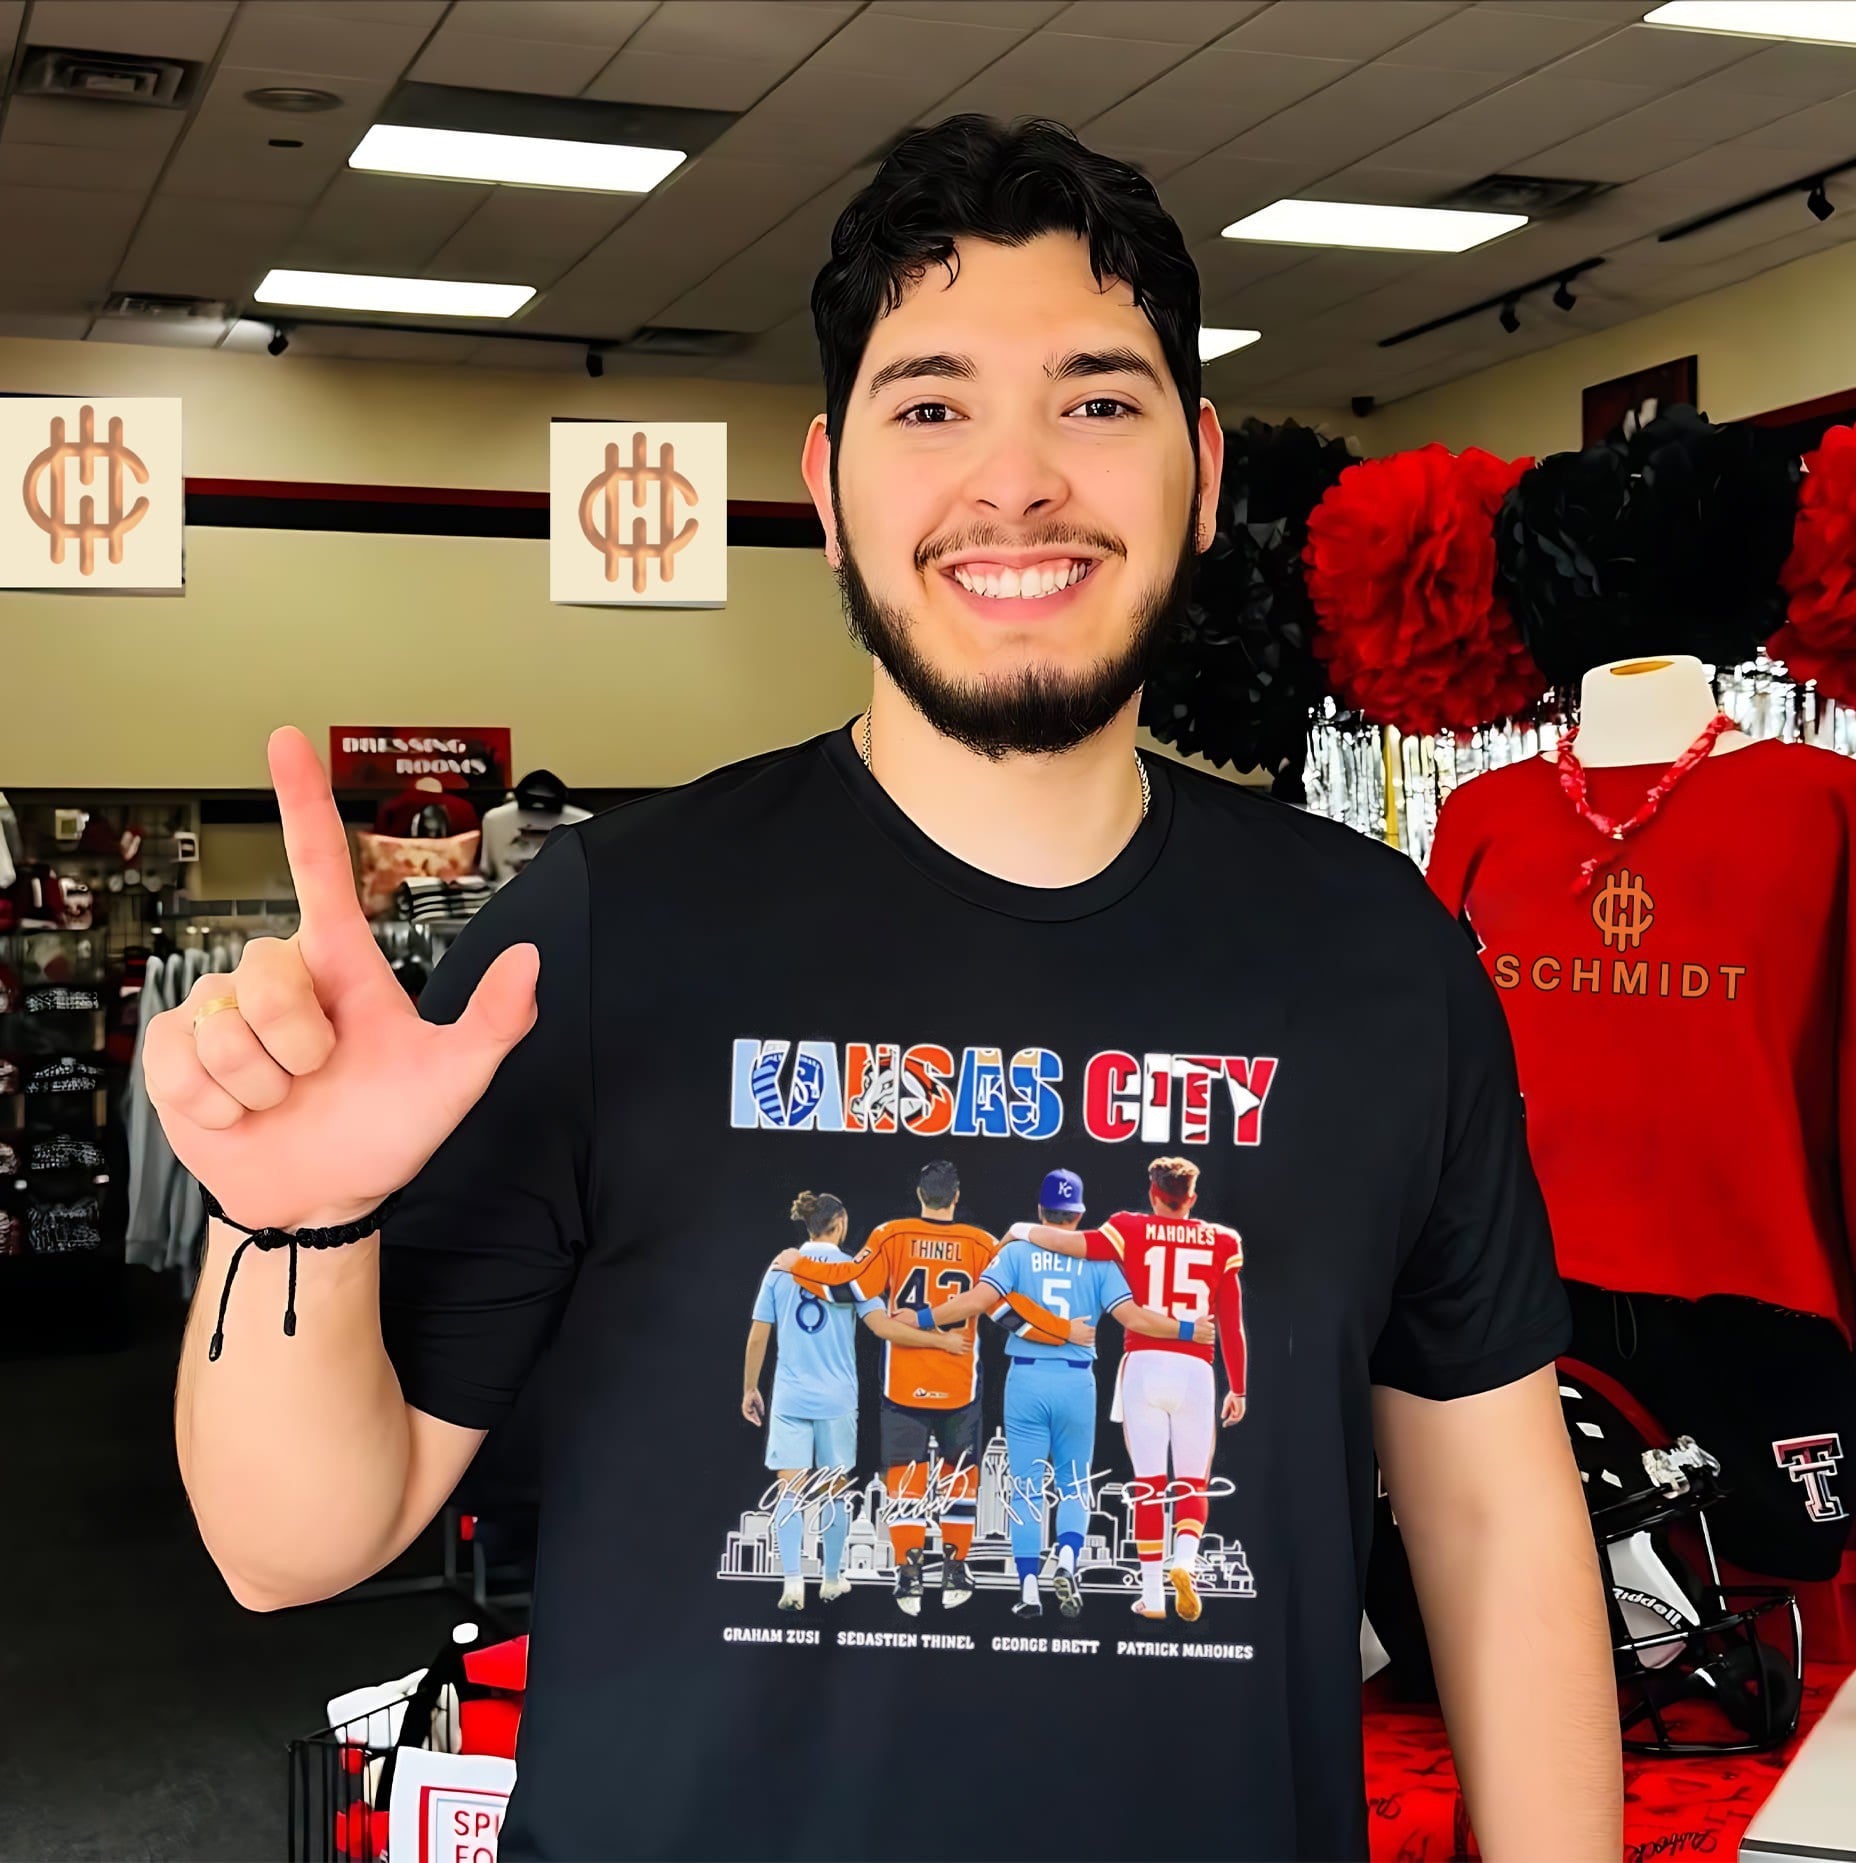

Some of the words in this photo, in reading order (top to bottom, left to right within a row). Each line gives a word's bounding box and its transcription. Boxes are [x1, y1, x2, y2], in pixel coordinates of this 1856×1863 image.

[342, 737, 467, 754] DRESSING
[396, 758, 487, 775] ROOMS
[1494, 954, 1747, 1000] SCHMIDT
[730, 1038, 1064, 1141] KANSAS
[1083, 1050, 1280, 1147] CITY
[1145, 1223, 1216, 1246] MAHOMES
[1143, 1245, 1214, 1323] 15
[795, 1286, 828, 1334] 8
[1042, 1278, 1072, 1321] 5
[723, 1627, 783, 1644] GRAHAM
[786, 1629, 821, 1645] ZUSI
[921, 1633, 975, 1650] THINEL
[991, 1636, 1048, 1652] GEORGE
[1052, 1639, 1100, 1654] BRETT
[1117, 1641, 1179, 1657] PATRICK
[1182, 1643, 1254, 1660] MAHOMES
